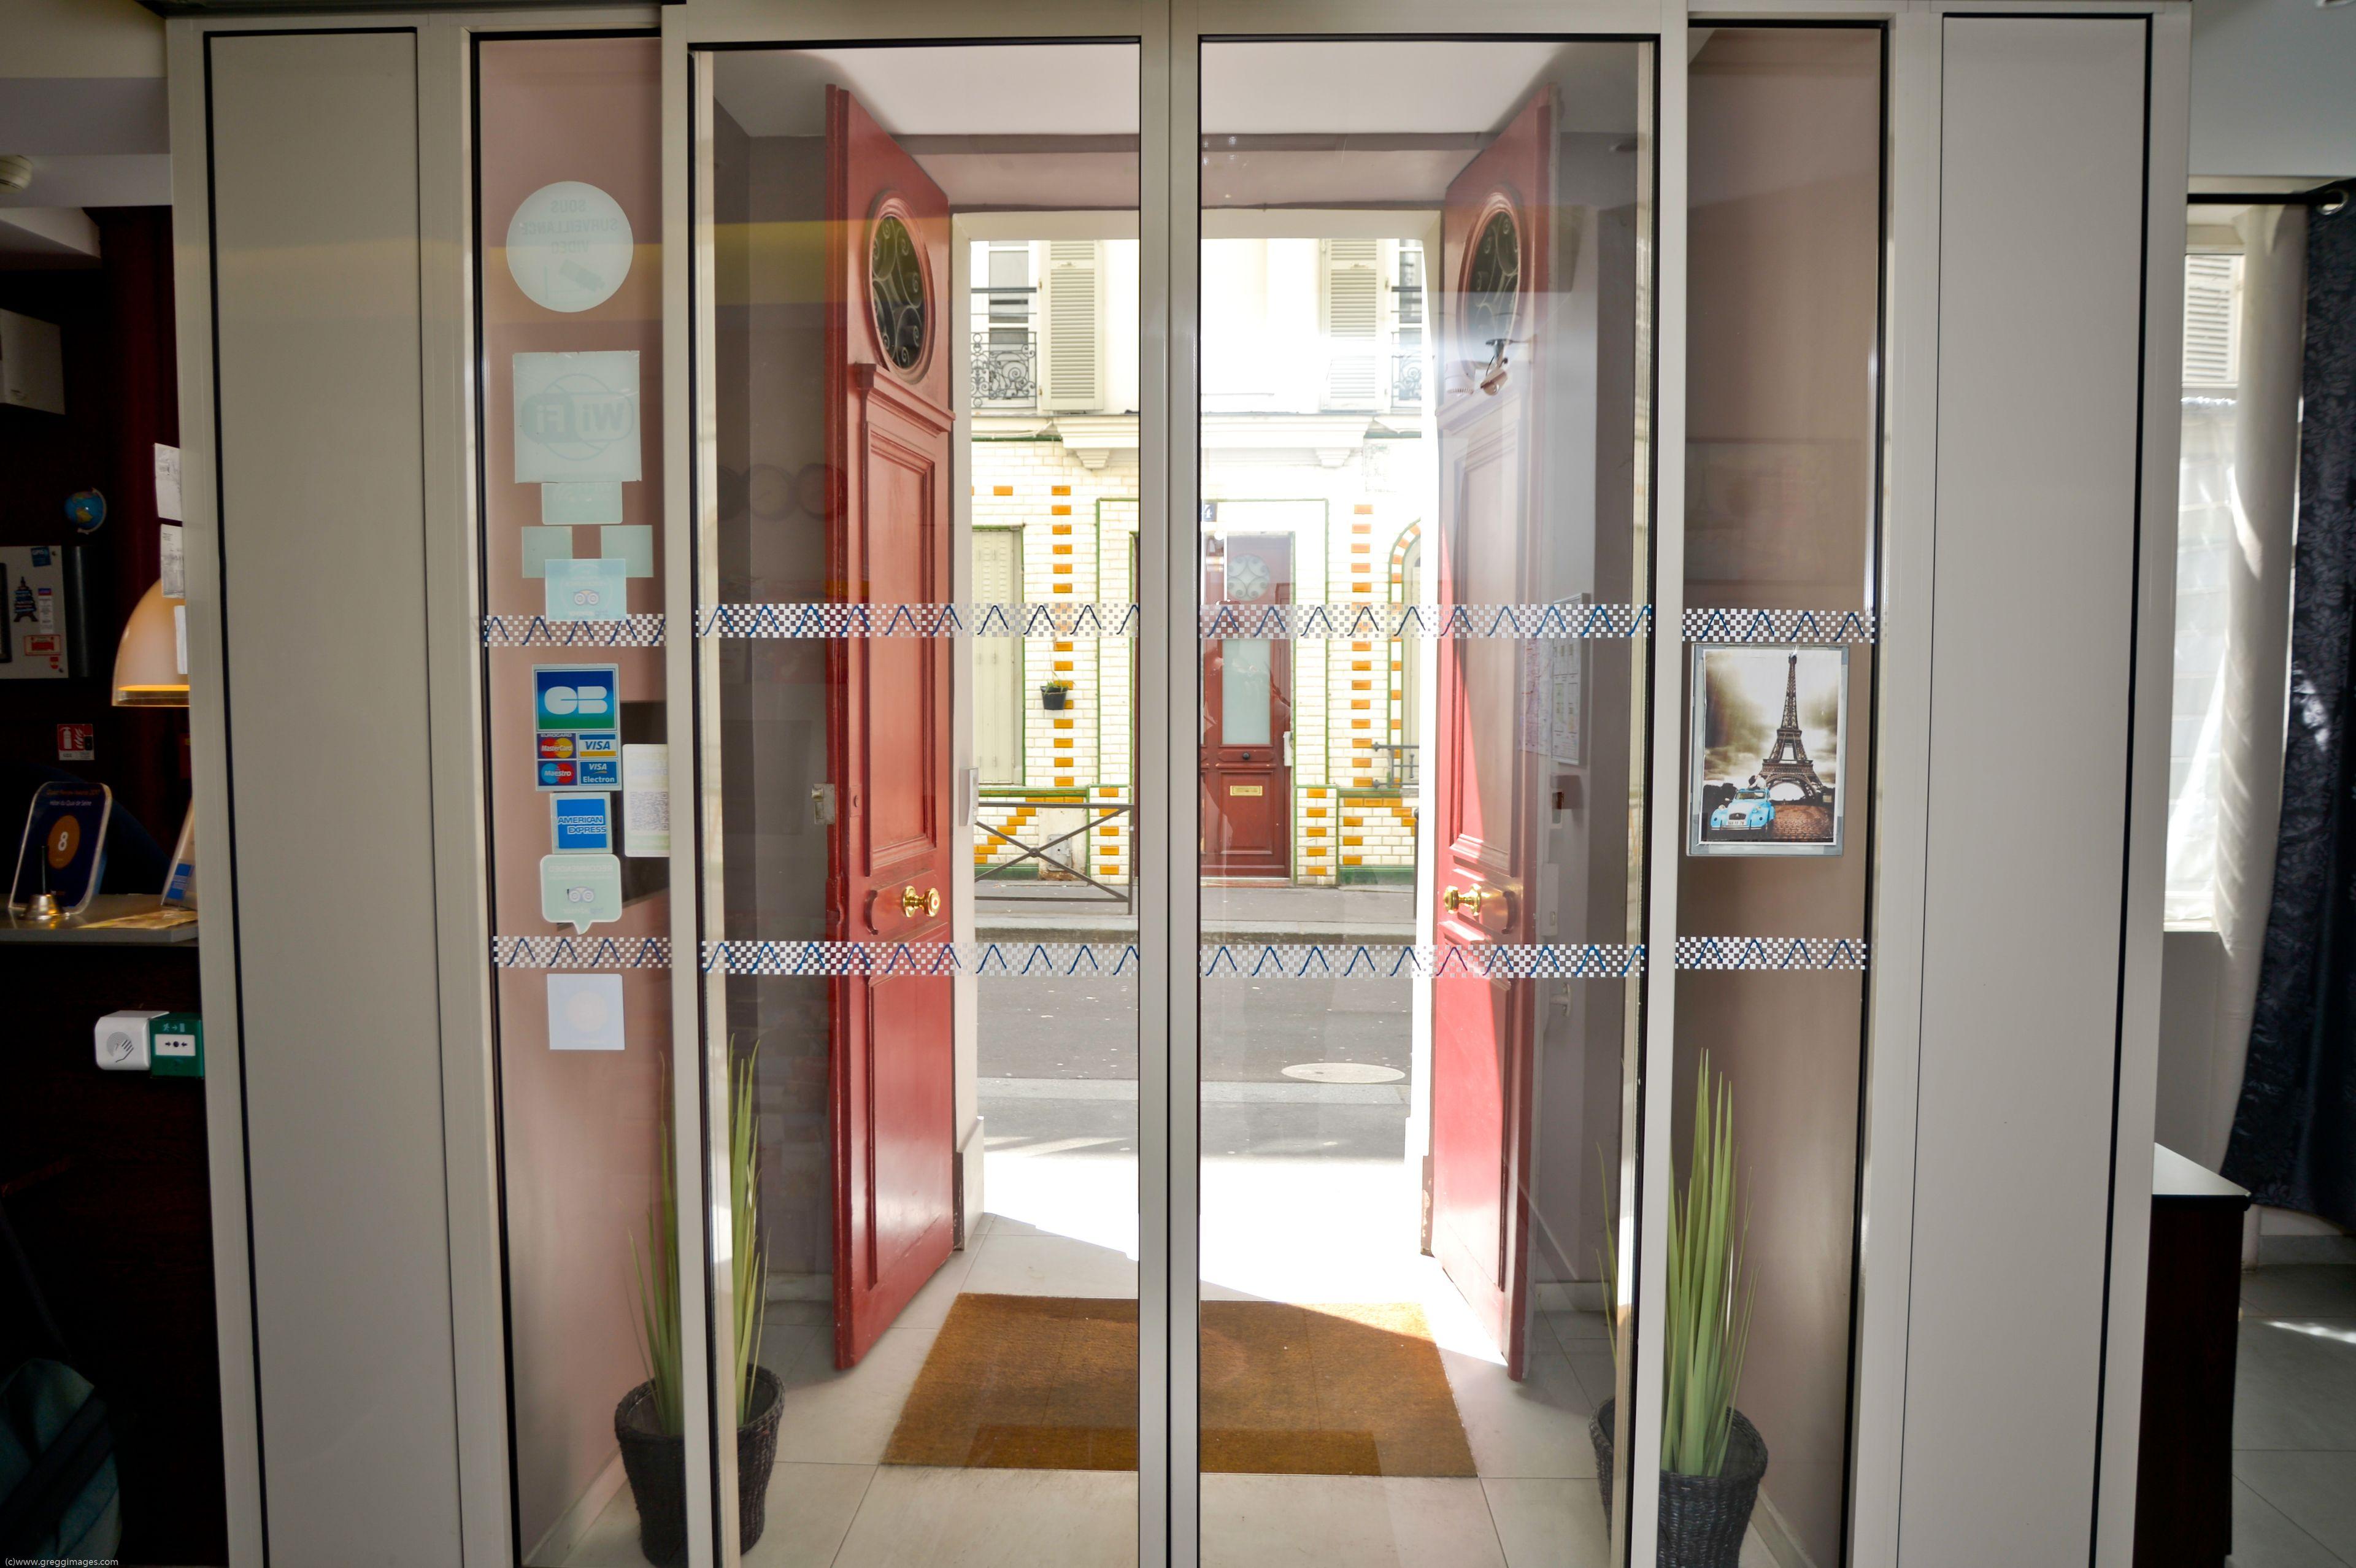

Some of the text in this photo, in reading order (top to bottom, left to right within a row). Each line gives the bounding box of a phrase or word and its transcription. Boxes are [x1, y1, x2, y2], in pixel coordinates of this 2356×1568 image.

[544, 686, 607, 715] CB
[585, 741, 610, 750] VISA
[558, 815, 604, 824] AMERICAN
[568, 826, 606, 834] EXPRESS
[58, 831, 69, 851] 8
